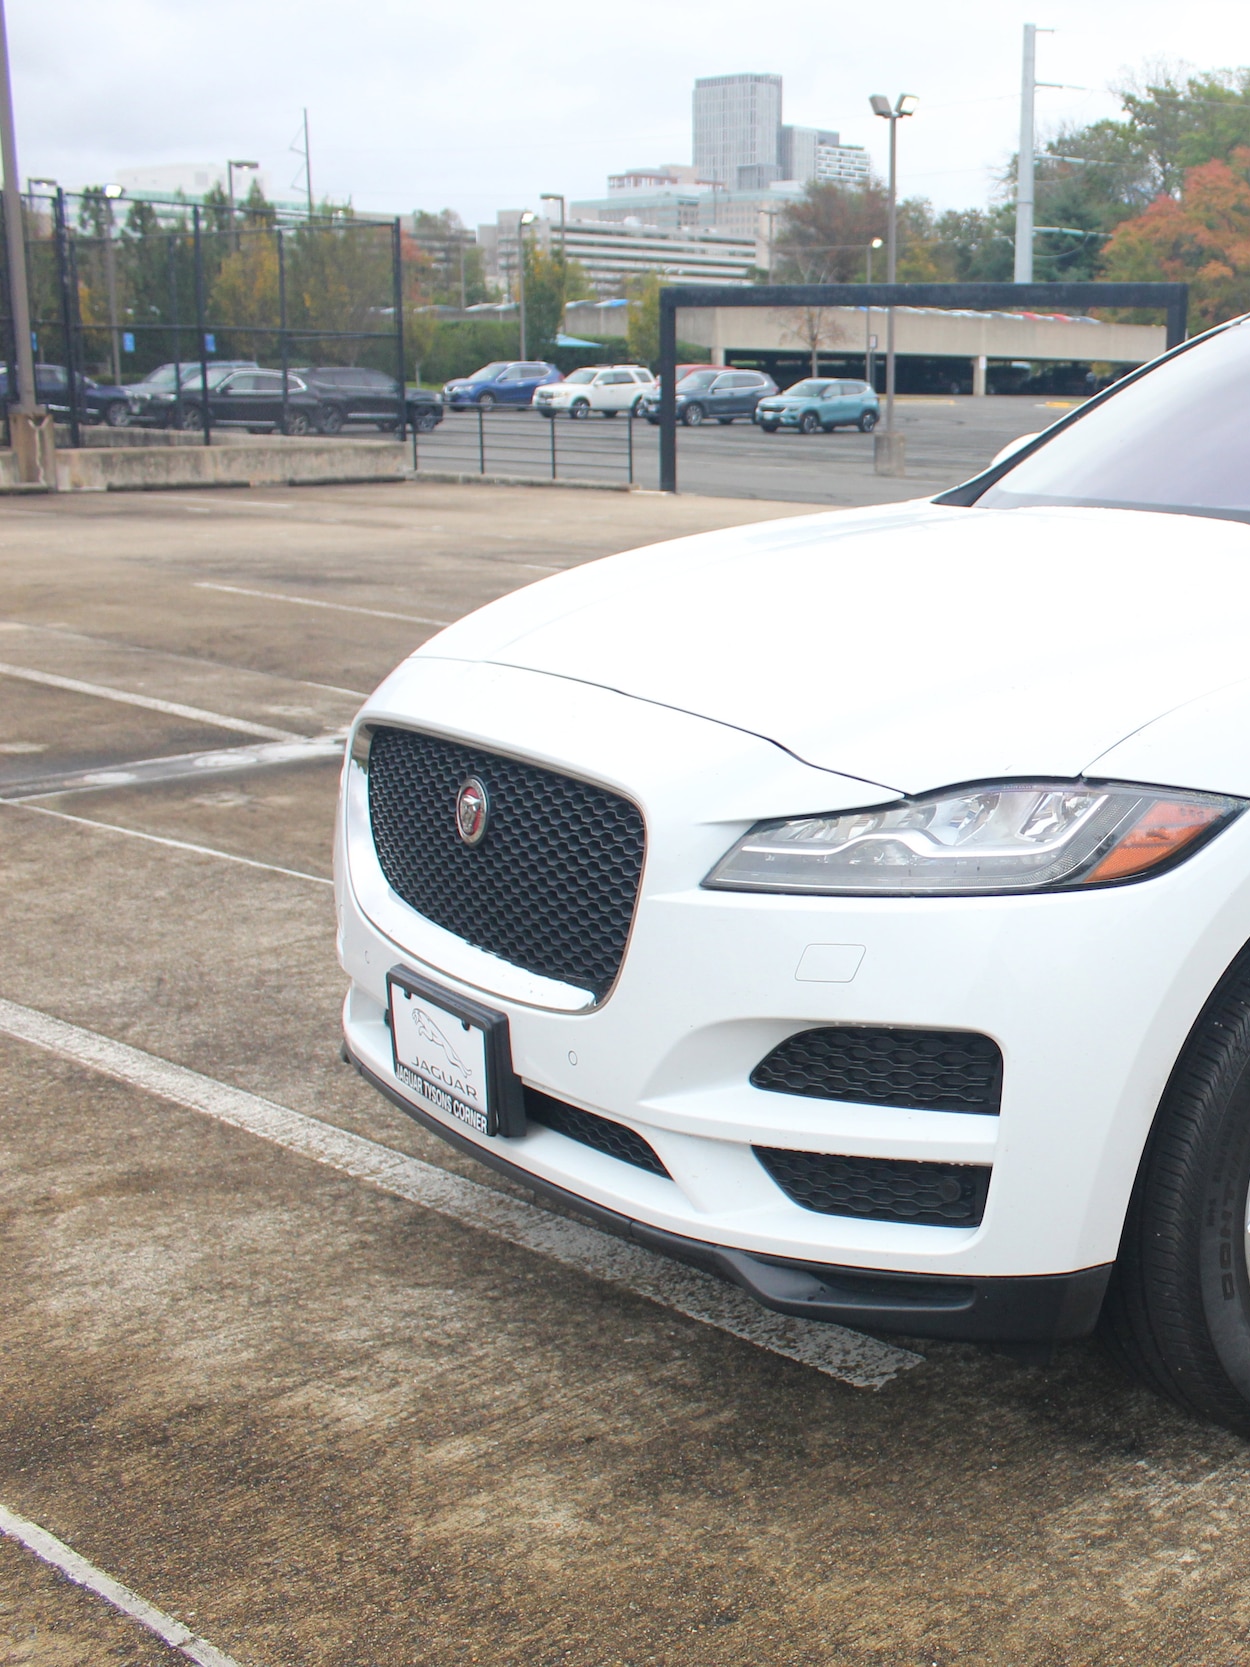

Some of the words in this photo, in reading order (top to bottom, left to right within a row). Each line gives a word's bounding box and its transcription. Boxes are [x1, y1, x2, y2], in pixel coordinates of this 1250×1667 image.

[396, 1063, 423, 1095] JAGUAR
[423, 1079, 453, 1113] TYSONS
[453, 1100, 488, 1134] CORNER
[412, 1056, 478, 1101] JAGUAR
